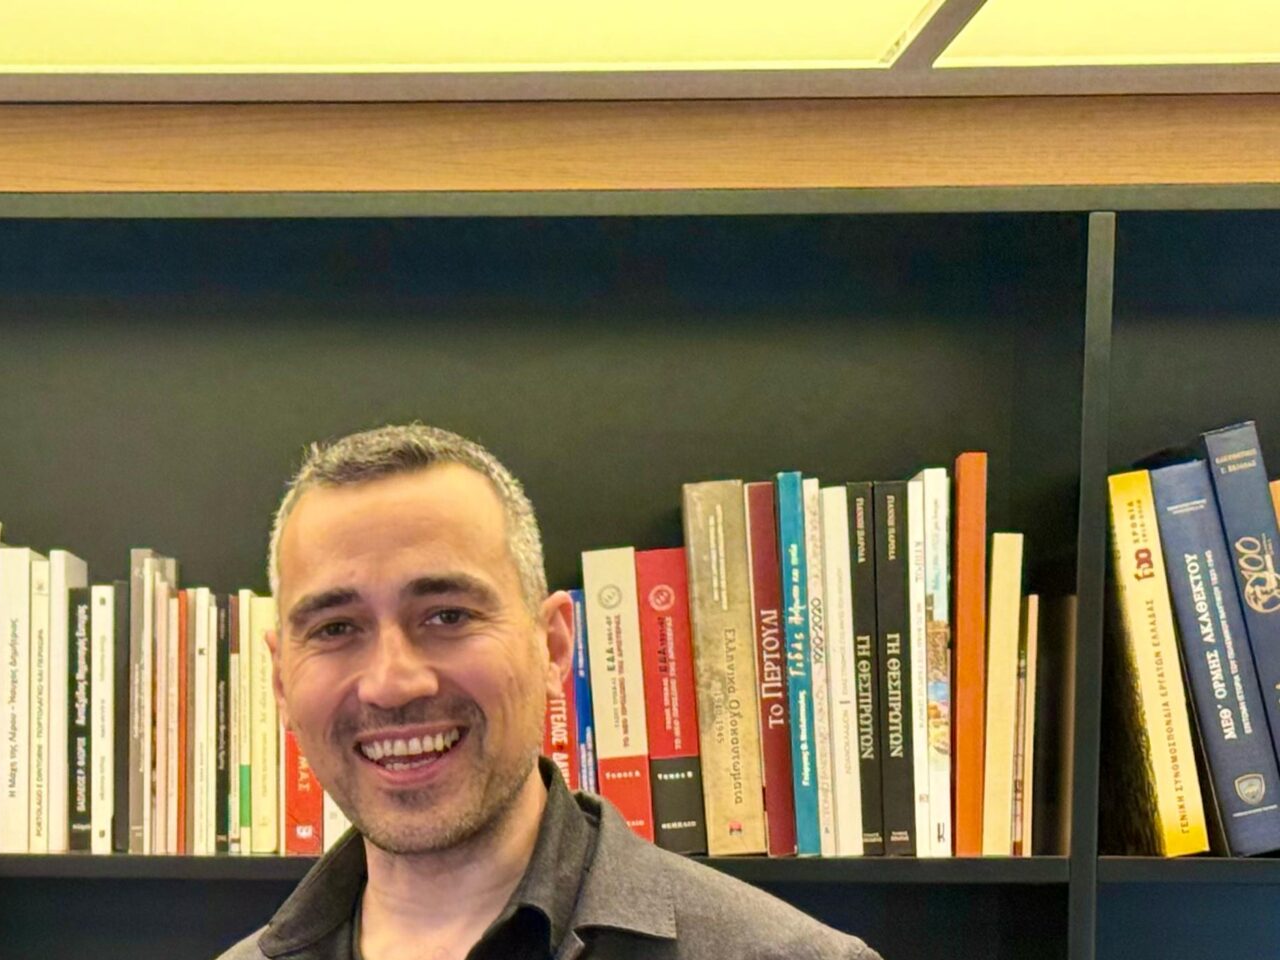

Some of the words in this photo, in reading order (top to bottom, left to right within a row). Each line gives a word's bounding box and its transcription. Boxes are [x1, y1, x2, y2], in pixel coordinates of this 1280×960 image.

[1144, 598, 1160, 647] ΕΛΛΑΔΑΣ
[1184, 551, 1216, 644] ΑΚΑΘΕΚΤΟΥ
[755, 608, 783, 699] ΠΕΡΤΟΥΛΙ
[810, 597, 823, 664] 1920-2020
[856, 635, 870, 657] ΓΗ
[886, 632, 900, 654] ΓΗ
[1152, 650, 1168, 697] ΕΡΓΑΤΩΝ
[1205, 648, 1228, 700] ΟΡΜΗΣ
[8, 713, 16, 742] Λέρου
[857, 660, 873, 758] ΘΕΣΠΡΩΤΩΝ
[886, 658, 902, 757] ΘΕΣΠΡΩΤΩΝ
[1159, 700, 1183, 791] ΣΥΝΟΜΟΣΠΟΝΔΙΑ
[8, 761, 16, 787] Μάχη
[1174, 795, 1190, 834] ΓΕΝΙΚΗ
